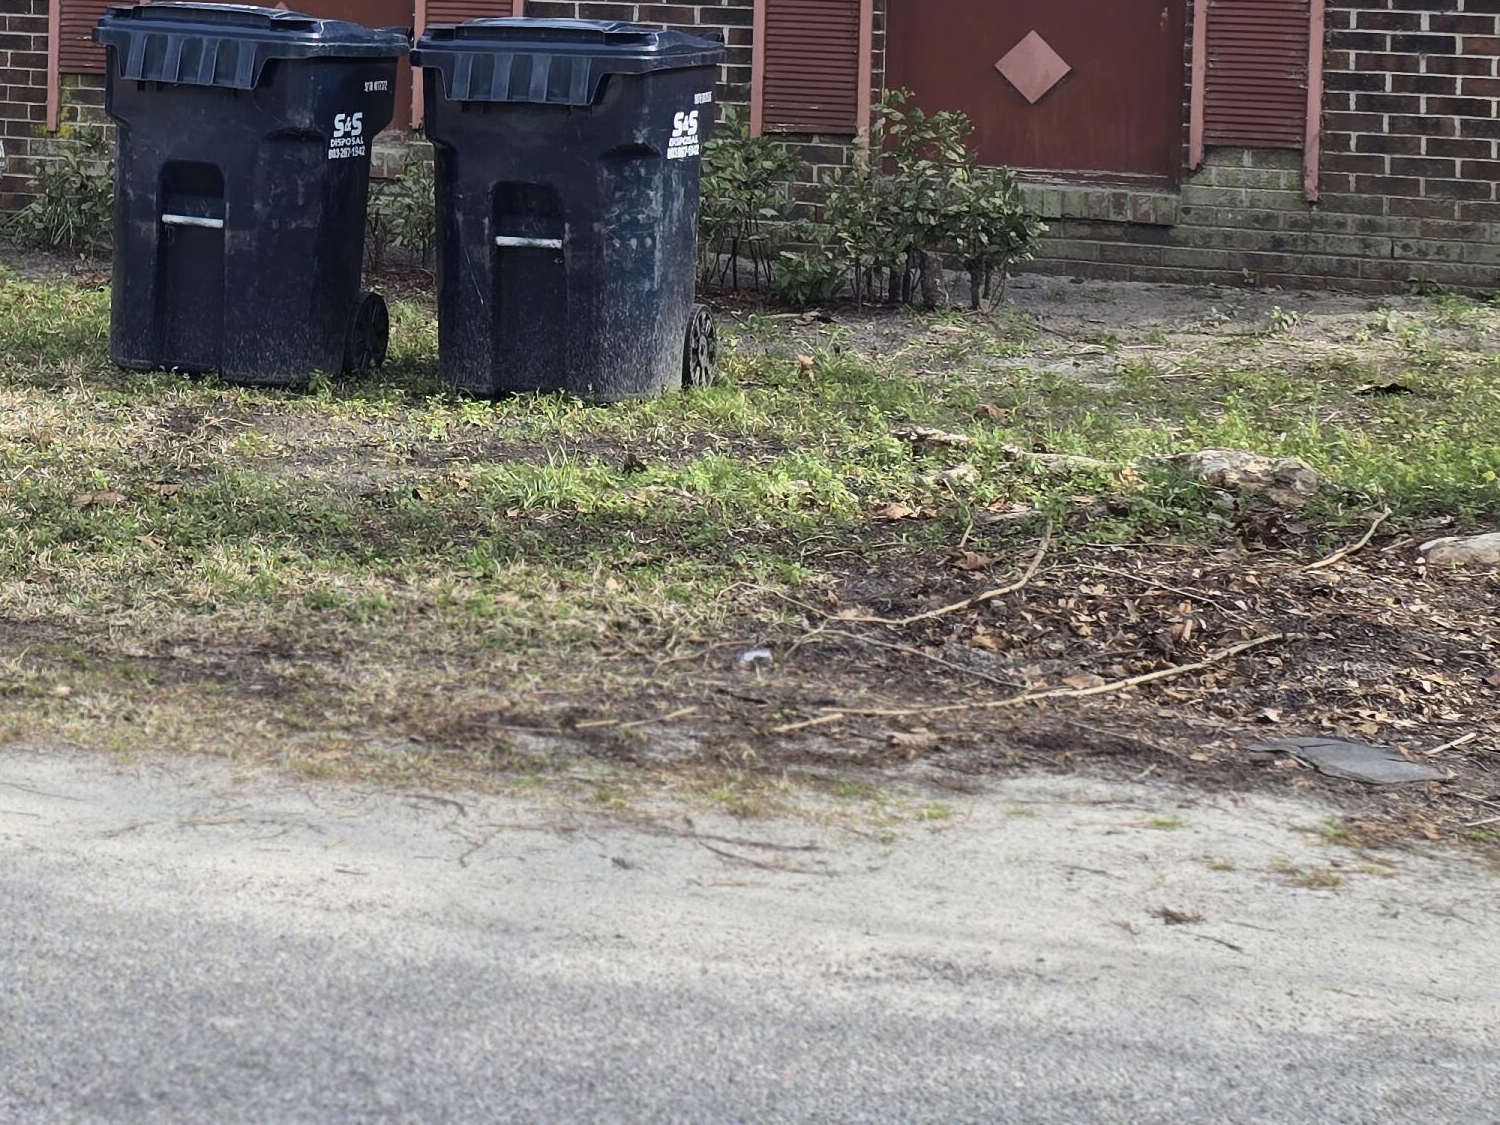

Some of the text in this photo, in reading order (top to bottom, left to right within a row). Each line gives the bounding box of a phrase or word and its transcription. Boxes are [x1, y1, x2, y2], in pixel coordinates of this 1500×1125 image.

[333, 112, 363, 138] S&S
[672, 110, 699, 137] S&S
[330, 136, 363, 147] DISPOSAL
